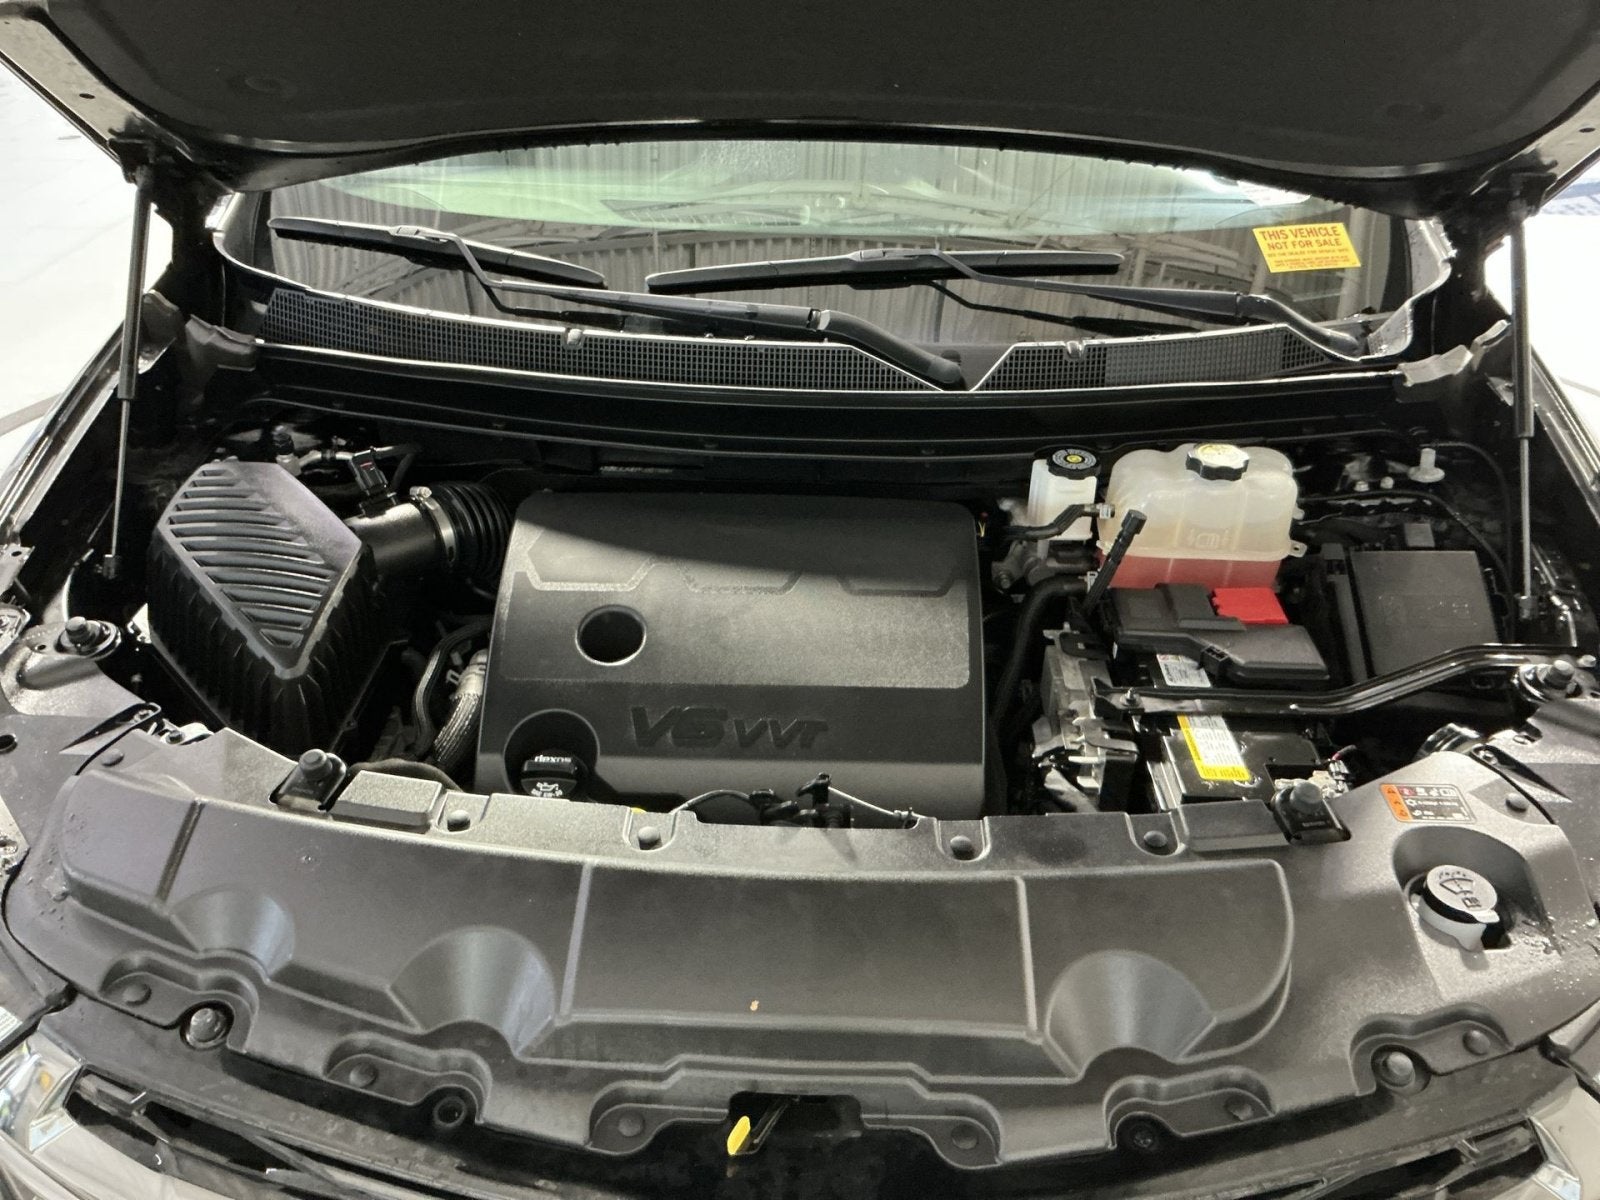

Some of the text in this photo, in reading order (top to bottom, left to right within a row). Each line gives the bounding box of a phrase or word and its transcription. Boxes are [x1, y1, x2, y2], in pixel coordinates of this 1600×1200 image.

[1259, 226, 1341, 241] THIS VEHICLE
[1267, 238, 1342, 251] NOT FOR SALE
[630, 704, 829, 750] V6 VVT
